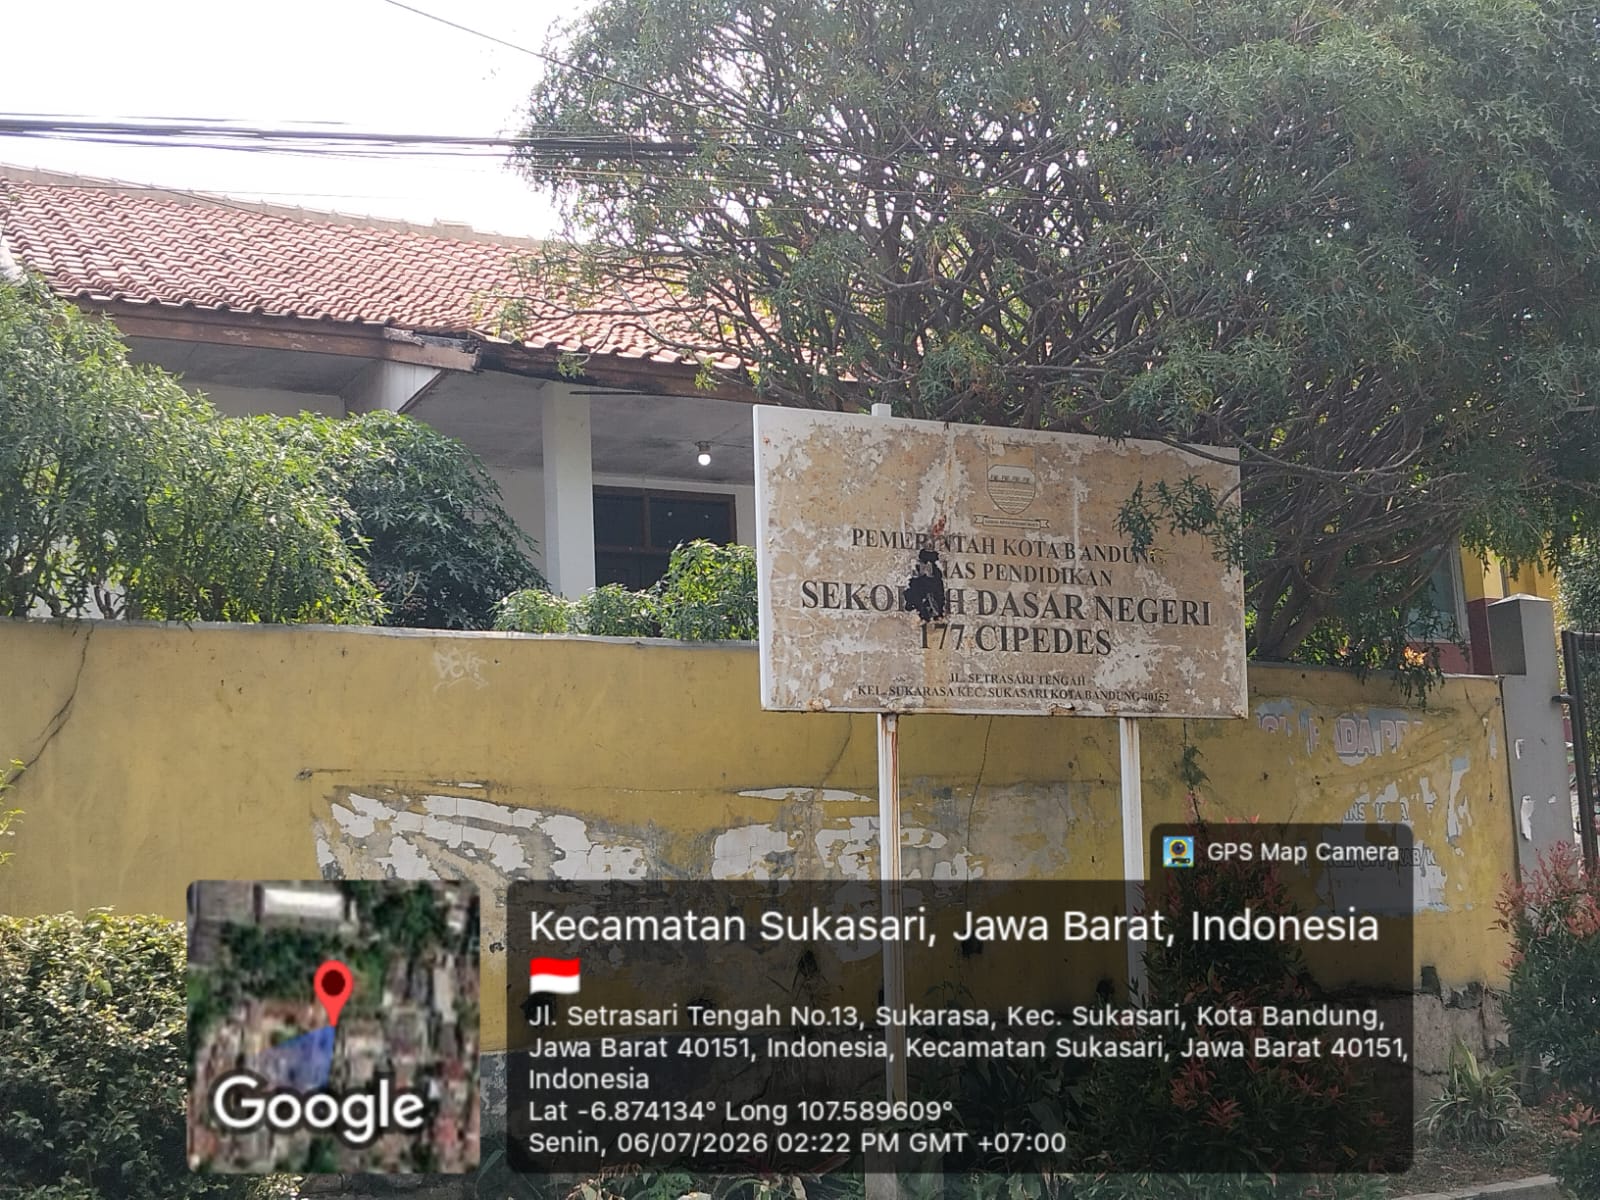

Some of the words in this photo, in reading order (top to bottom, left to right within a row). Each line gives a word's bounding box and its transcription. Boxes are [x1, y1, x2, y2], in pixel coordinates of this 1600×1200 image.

[1003, 537, 1060, 560] KOTA
[983, 562, 1113, 587] PENDIDIKAN
[801, 579, 966, 615] SEKOLH
[976, 589, 1086, 620] DASAR
[1094, 595, 1212, 626] NEGERI
[920, 622, 966, 652] 177
[974, 624, 1113, 656] CIPEDES
[967, 672, 1035, 685] SETRASARI
[1038, 674, 1087, 687] TENGAH
[858, 685, 887, 697] KEL.
[888, 685, 955, 698] SUKARASA
[957, 686, 986, 699] KEC.
[988, 687, 1048, 700] SUKASARI
[1049, 688, 1083, 700] KOTA
[1085, 689, 1139, 702] BANDUNG
